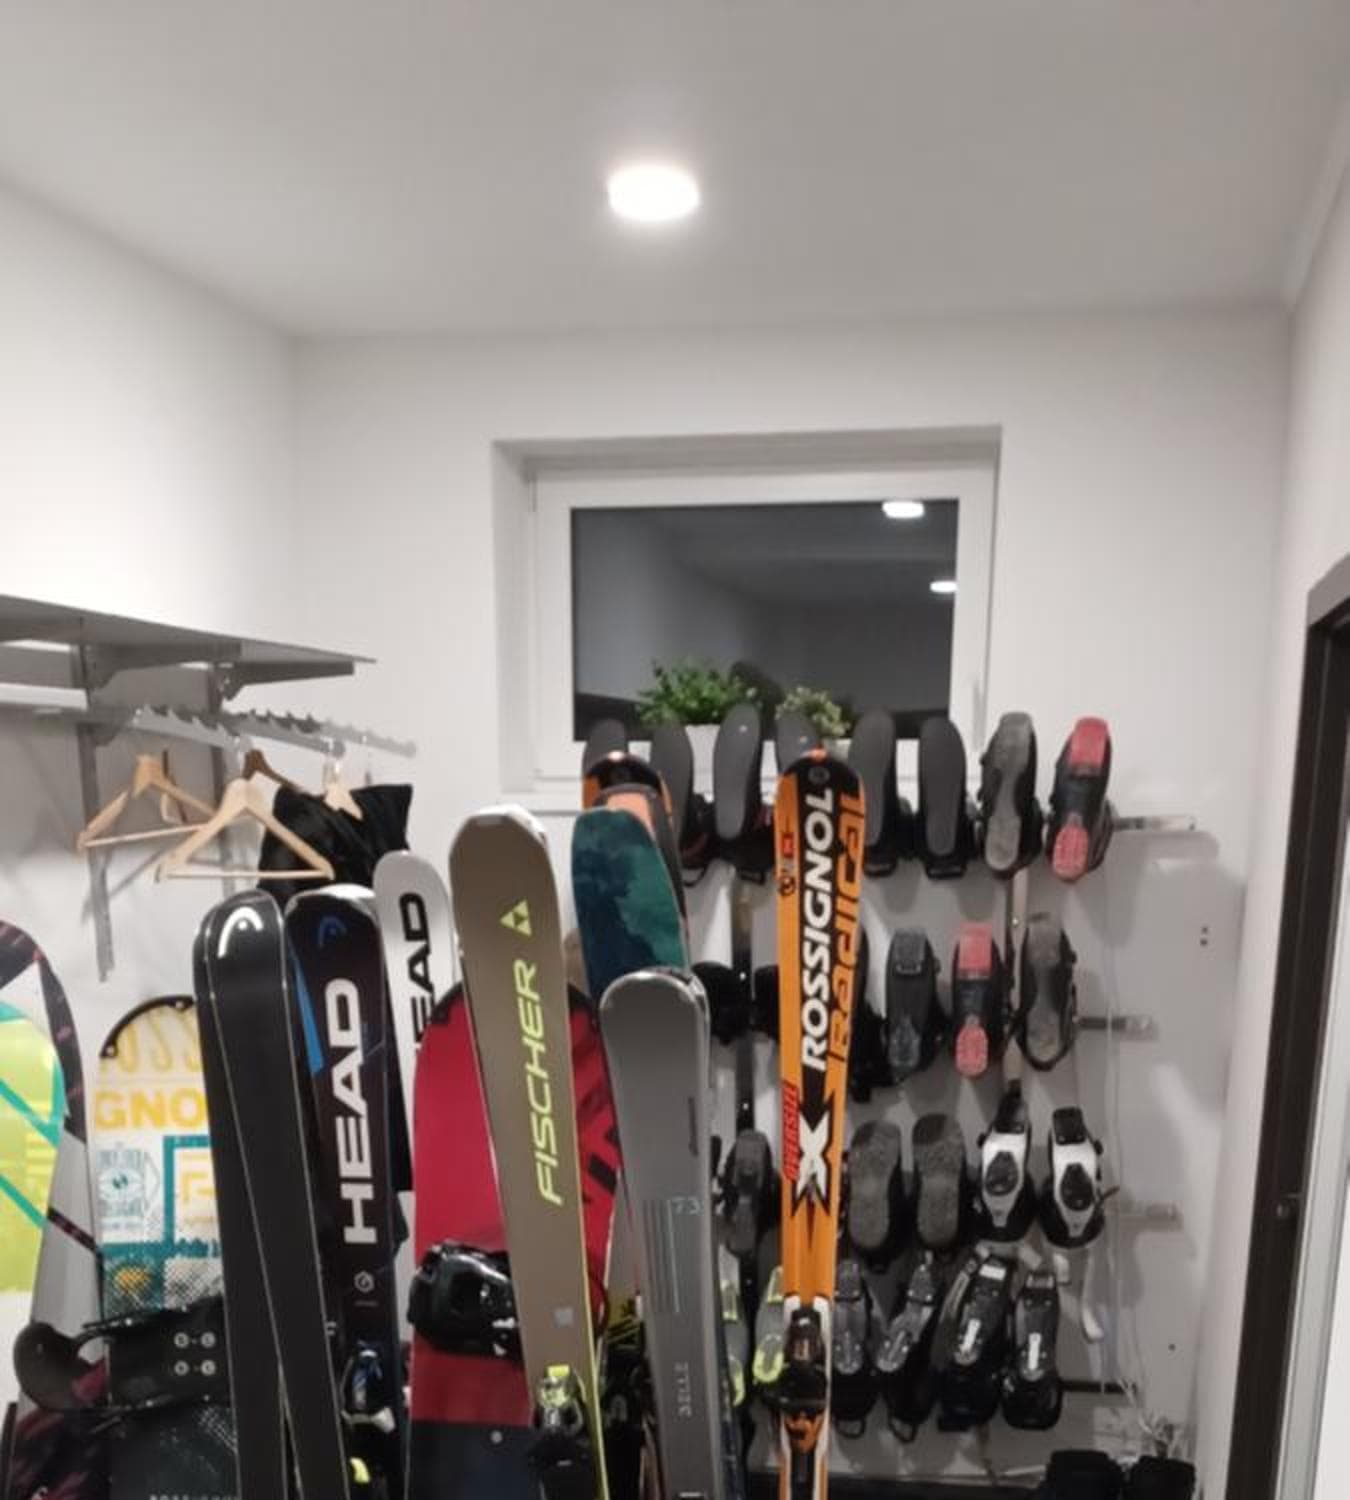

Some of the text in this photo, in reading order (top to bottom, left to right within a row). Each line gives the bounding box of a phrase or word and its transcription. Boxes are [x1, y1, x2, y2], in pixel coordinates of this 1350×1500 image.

[802, 790, 833, 1072] ROSSIGNOL
[325, 978, 377, 1244] HEAD
[513, 959, 562, 1206] FISCHER
